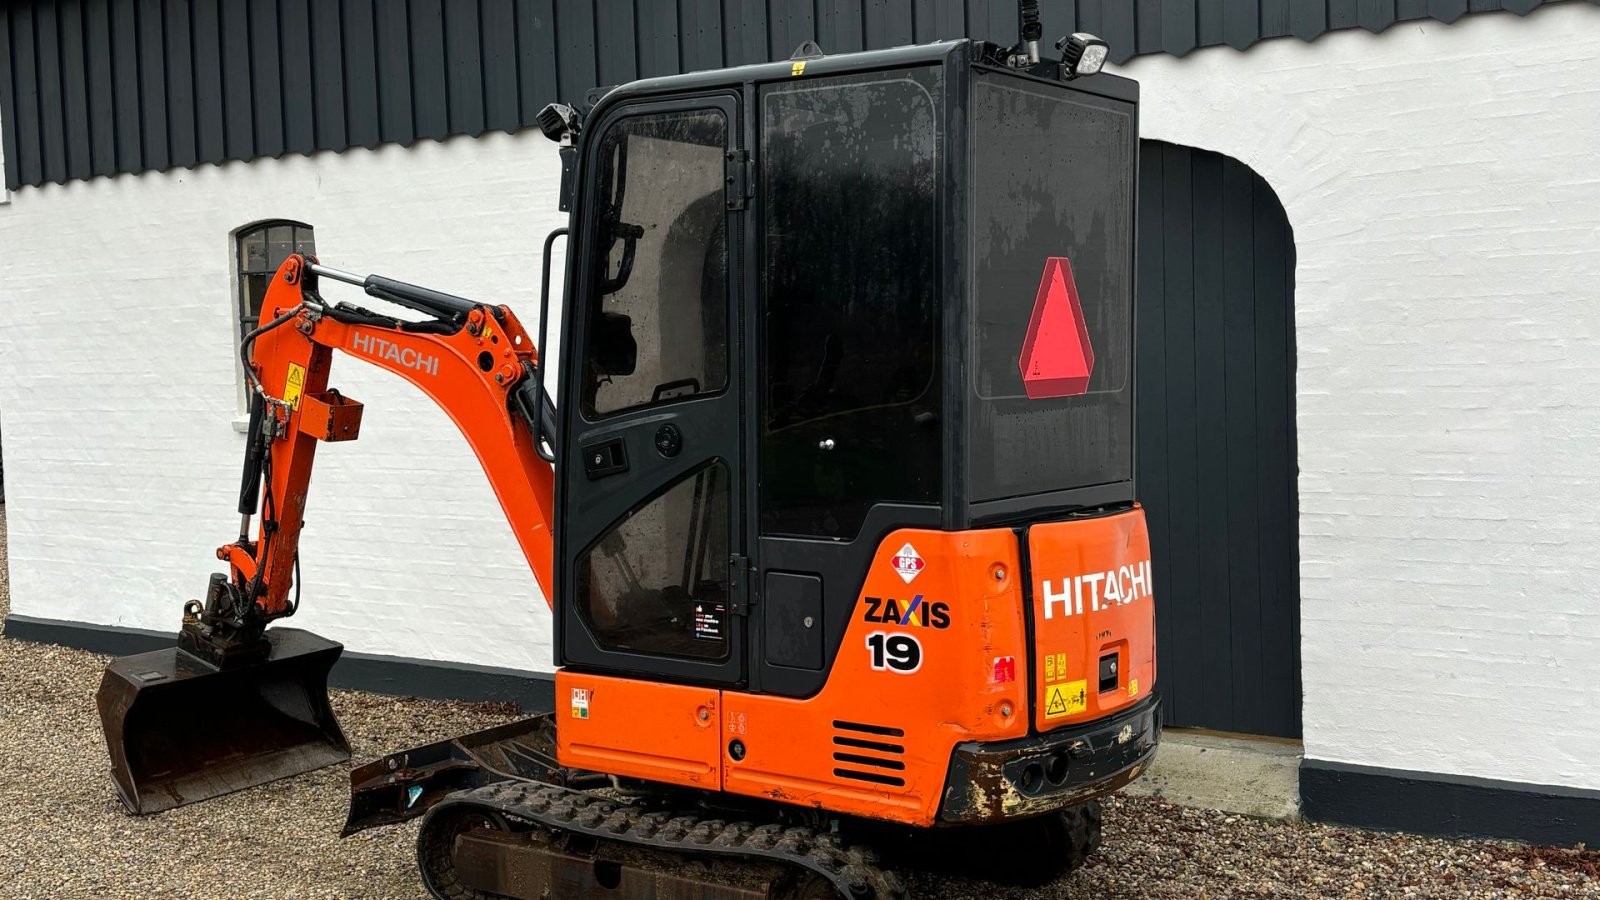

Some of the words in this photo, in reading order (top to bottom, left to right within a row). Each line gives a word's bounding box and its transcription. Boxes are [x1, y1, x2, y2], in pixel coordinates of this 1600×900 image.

[353, 332, 439, 376] HITACHI
[898, 557, 917, 569] GPS
[1042, 560, 1152, 620] HITACHI
[864, 594, 951, 629] ZAXIS
[868, 633, 921, 671] 19
